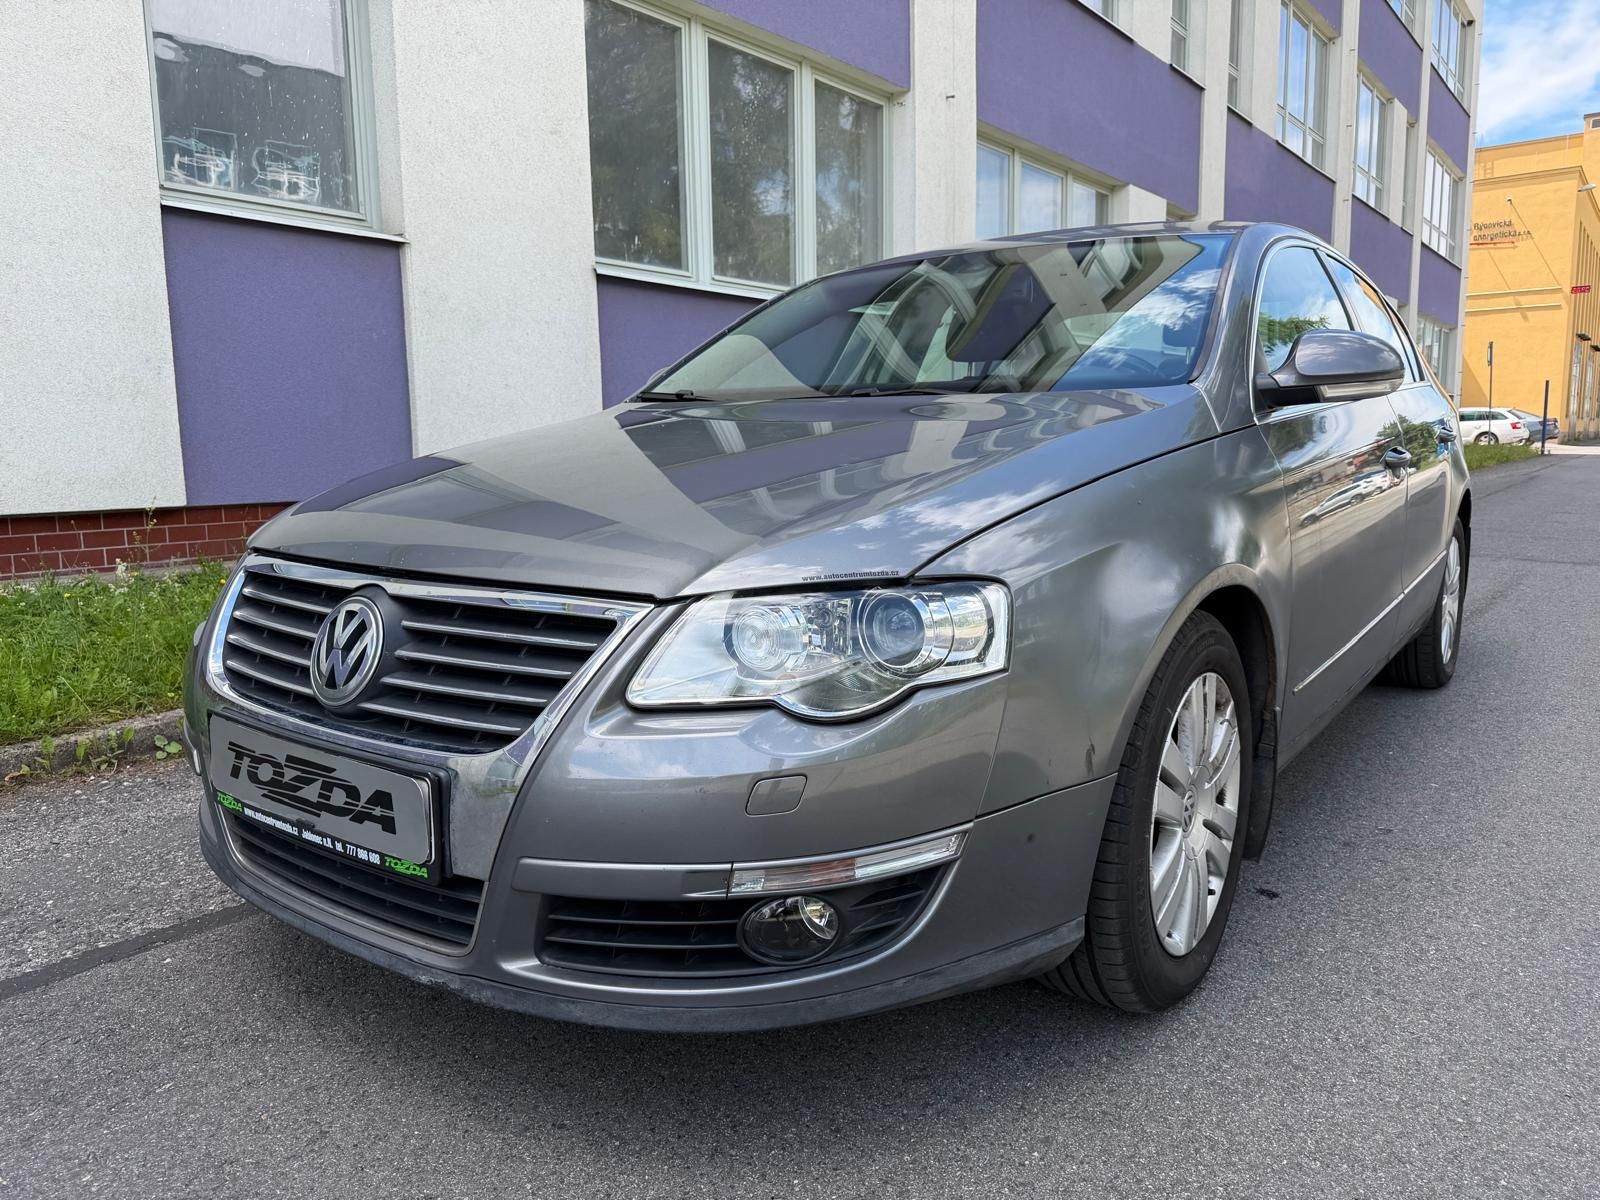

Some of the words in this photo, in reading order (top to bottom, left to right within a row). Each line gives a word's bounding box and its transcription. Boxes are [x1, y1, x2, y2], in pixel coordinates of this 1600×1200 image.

[801, 570, 900, 582] www.autocentrumtozda.cz
[314, 600, 380, 699] VW
[228, 741, 397, 835] TOZDA
[216, 792, 243, 813] TOZDA
[346, 844, 357, 857] 777
[384, 856, 428, 879] TOZDA
